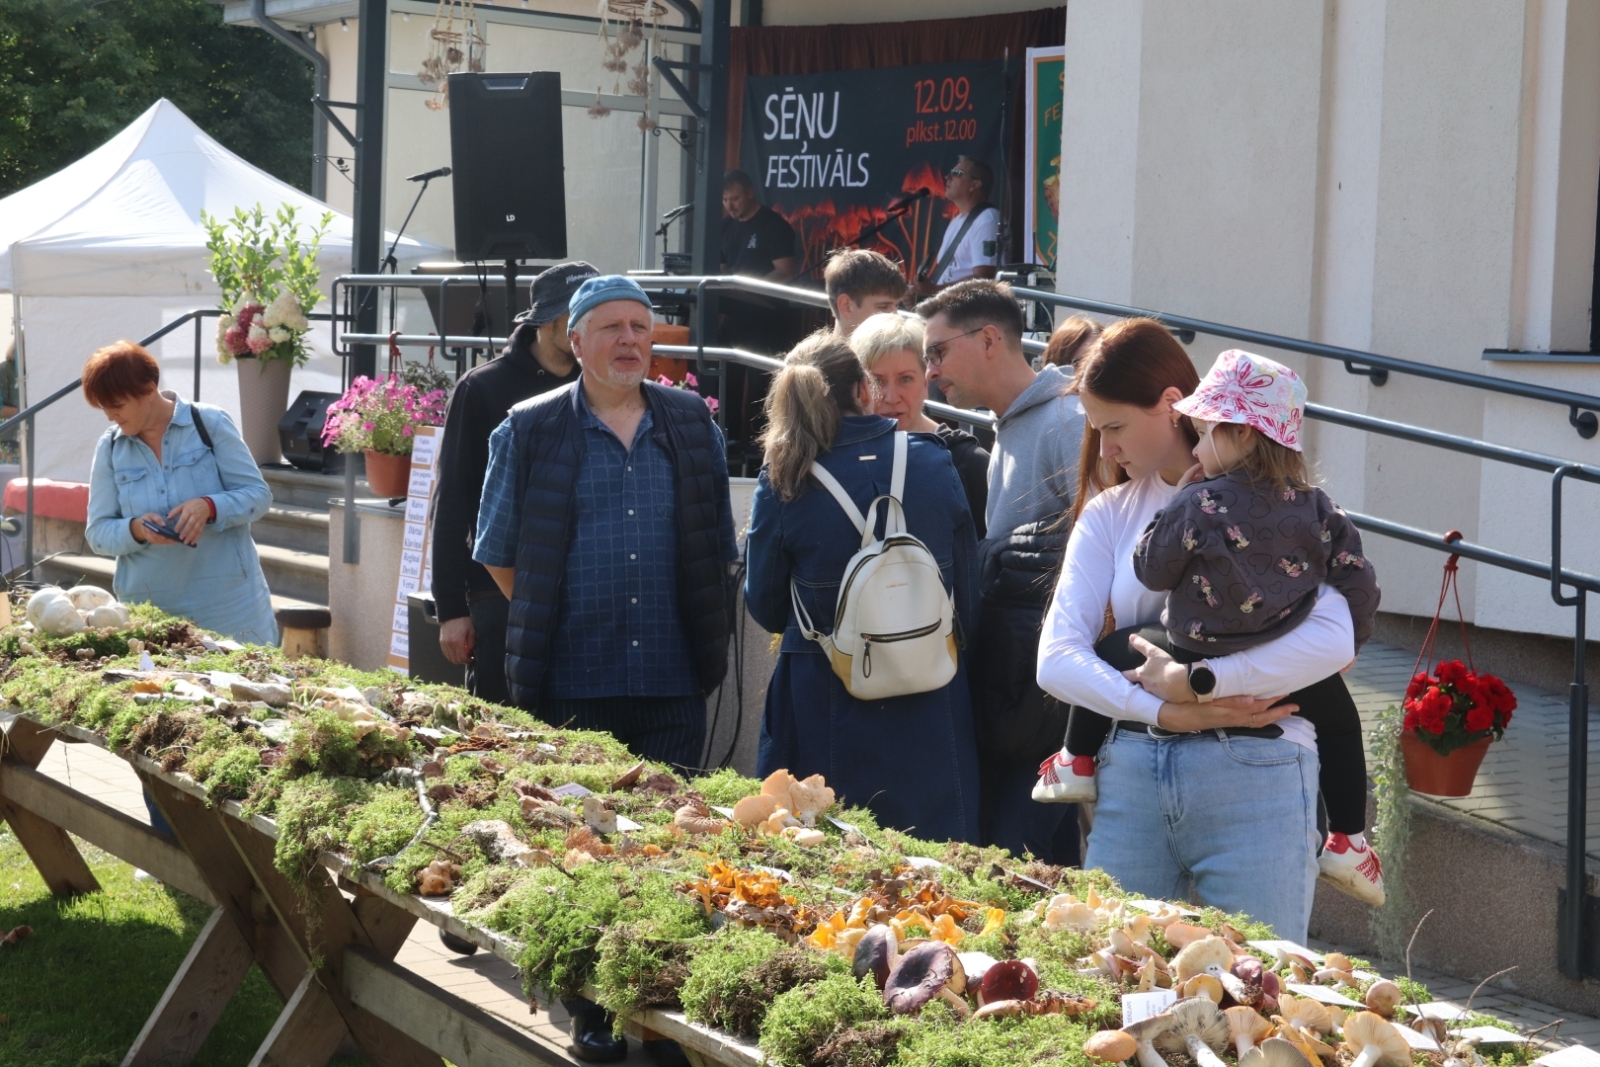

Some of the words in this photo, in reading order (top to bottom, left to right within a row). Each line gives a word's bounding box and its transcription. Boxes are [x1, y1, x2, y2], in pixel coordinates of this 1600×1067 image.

[914, 76, 974, 114] 12.09.
[763, 87, 840, 153] SĒŅU
[765, 148, 870, 188] FESTIVĀLS
